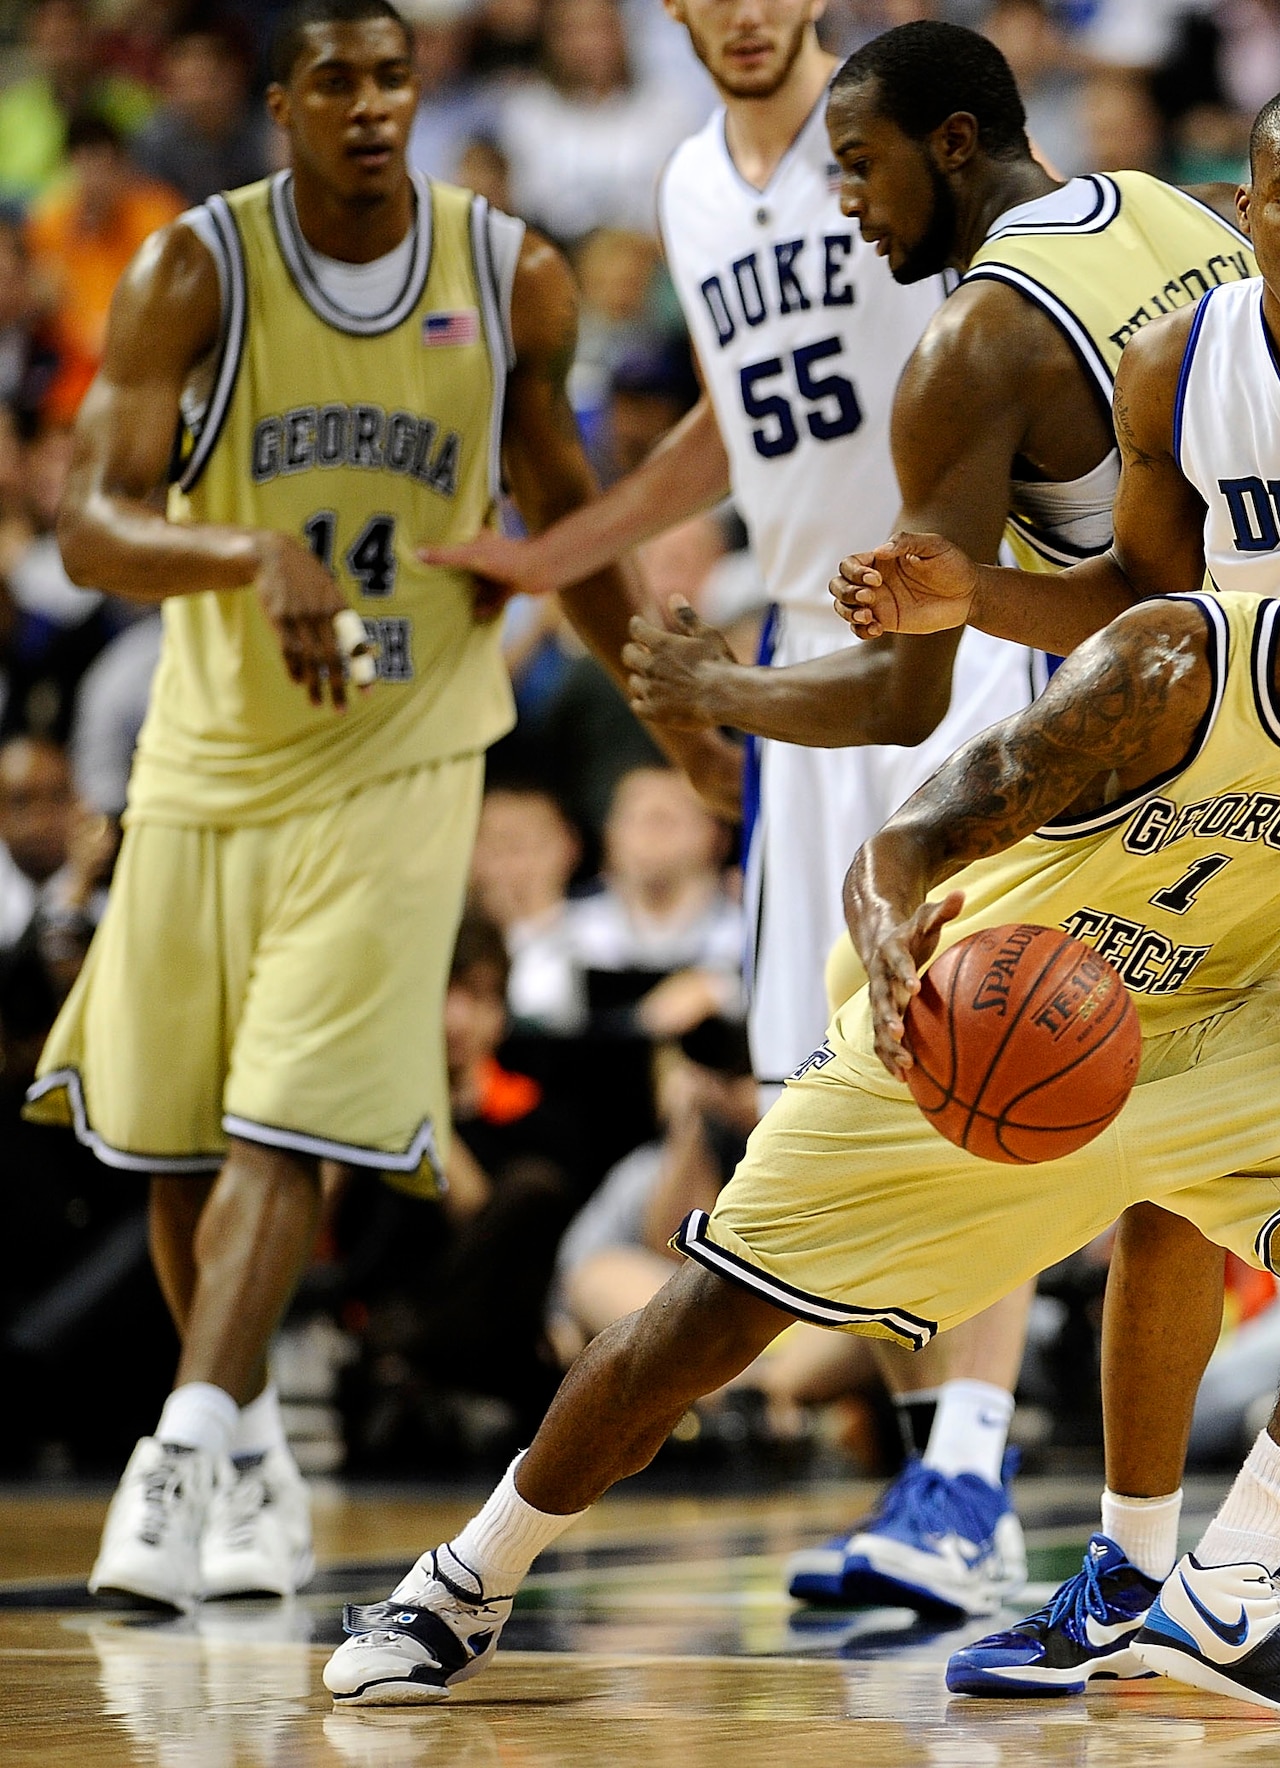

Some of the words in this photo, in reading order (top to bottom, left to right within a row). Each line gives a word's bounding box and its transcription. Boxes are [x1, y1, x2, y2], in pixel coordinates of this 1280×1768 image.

[701, 234, 855, 348] DUKE
[740, 336, 862, 458] 55
[251, 402, 461, 498] GEORGIA
[304, 508, 396, 597] 14
[1148, 851, 1235, 916] 1
[972, 924, 1046, 1017] SPALD
[1058, 906, 1215, 995] TECH
